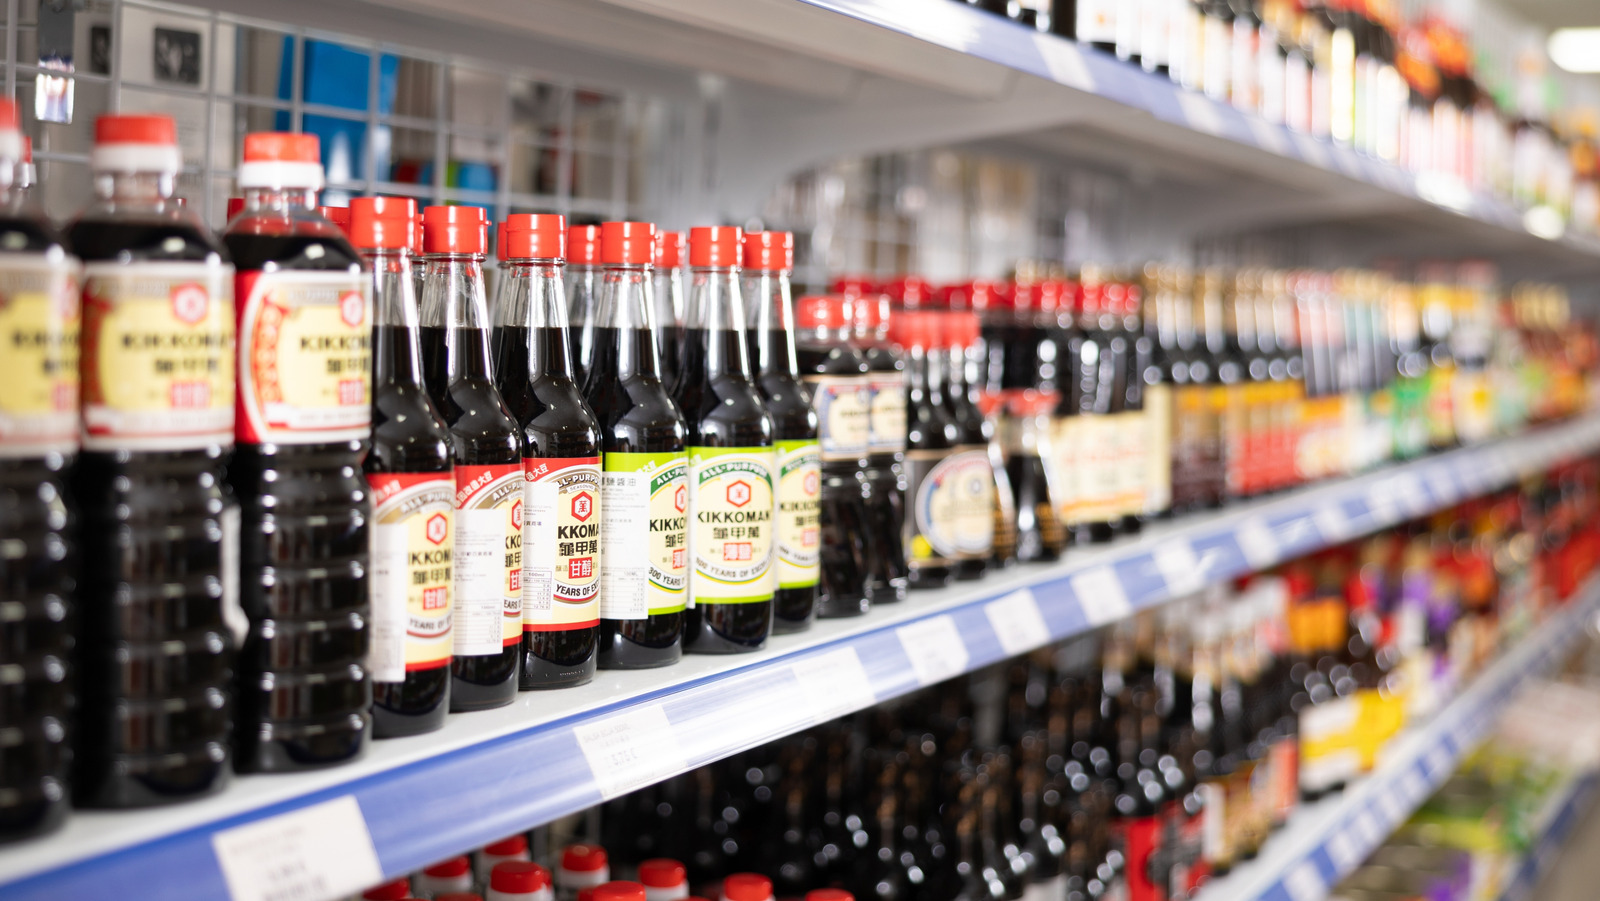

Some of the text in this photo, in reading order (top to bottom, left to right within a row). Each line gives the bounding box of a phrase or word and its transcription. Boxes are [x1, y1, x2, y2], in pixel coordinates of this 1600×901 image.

[648, 566, 662, 580] 300
[556, 583, 581, 597] YEARS
[582, 587, 591, 596] OF
